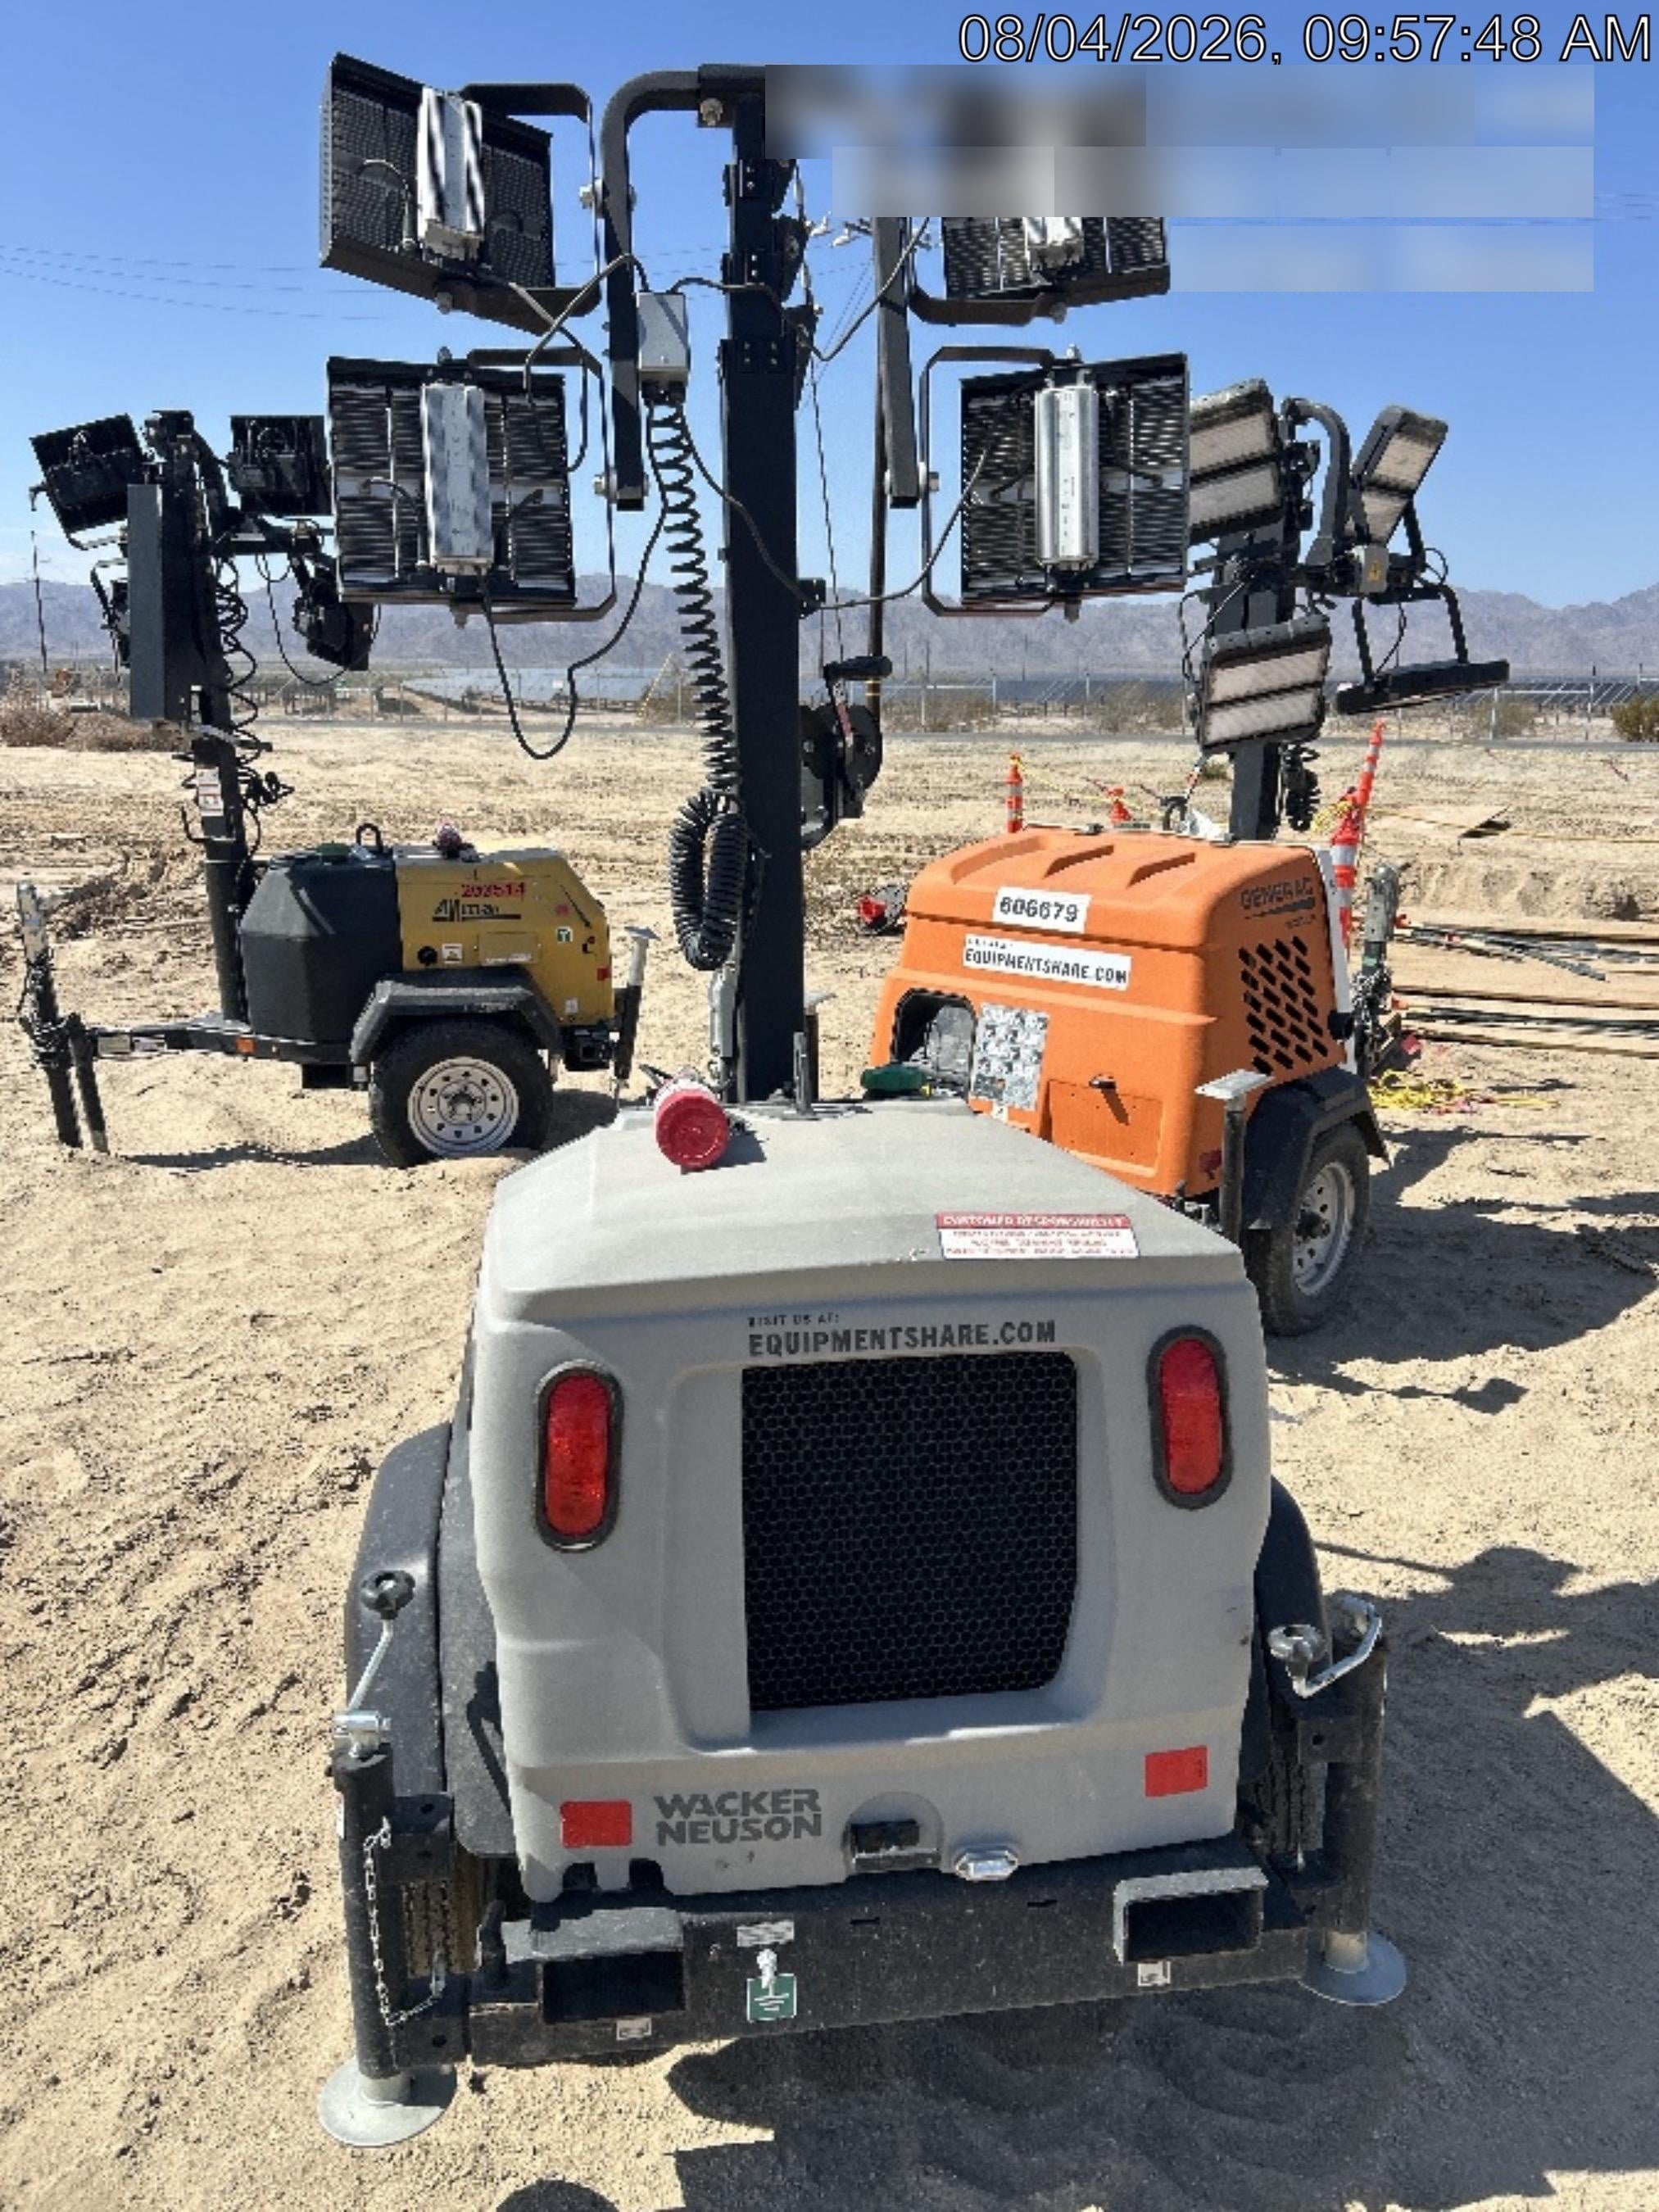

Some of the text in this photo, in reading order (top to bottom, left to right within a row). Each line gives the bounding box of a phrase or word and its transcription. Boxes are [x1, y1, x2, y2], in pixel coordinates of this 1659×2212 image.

[749, 1319, 1057, 1357] EQUIPMENTSHARE.COM
[653, 1788, 823, 1820] WACKER
[655, 1813, 823, 1847] NEUSON
